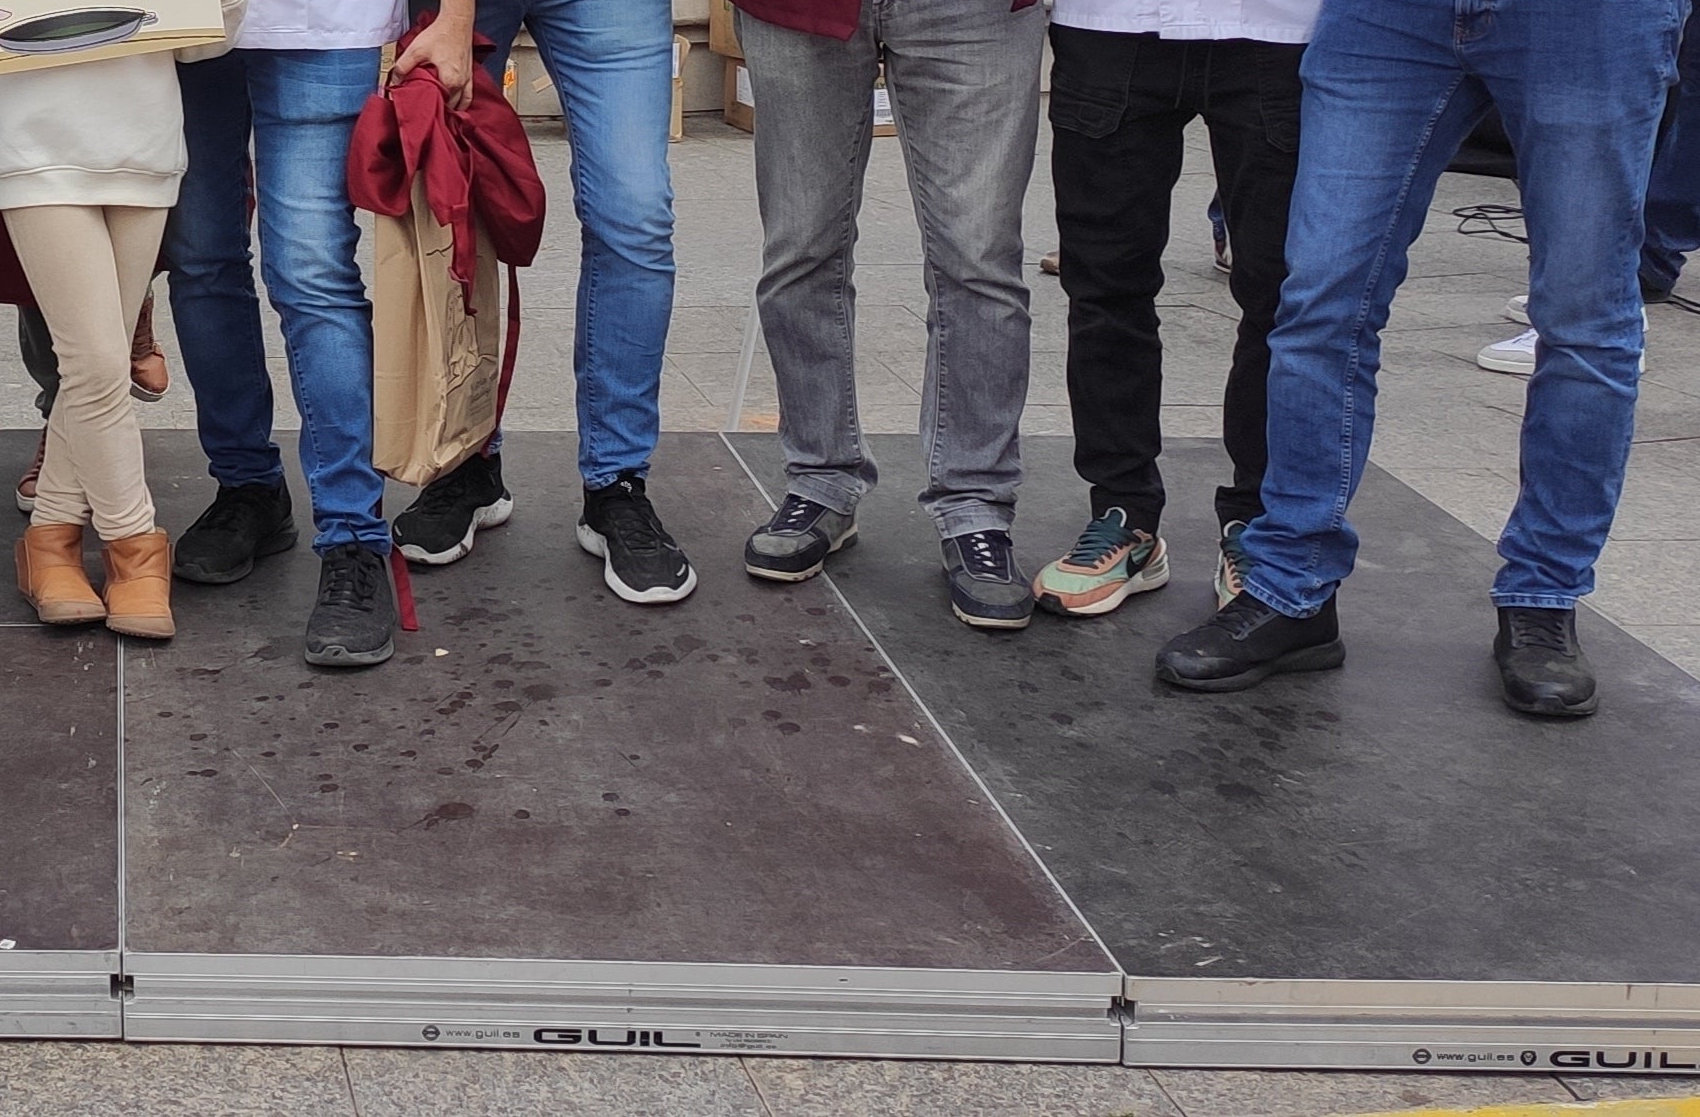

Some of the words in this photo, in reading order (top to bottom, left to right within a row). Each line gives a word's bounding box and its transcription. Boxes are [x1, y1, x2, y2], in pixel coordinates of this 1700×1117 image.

[446, 1028, 521, 1040] www.guil.es
[533, 1027, 701, 1048] GUIL
[1436, 1052, 1515, 1063] www.guil.es
[1549, 1050, 1697, 1069] GUIL
